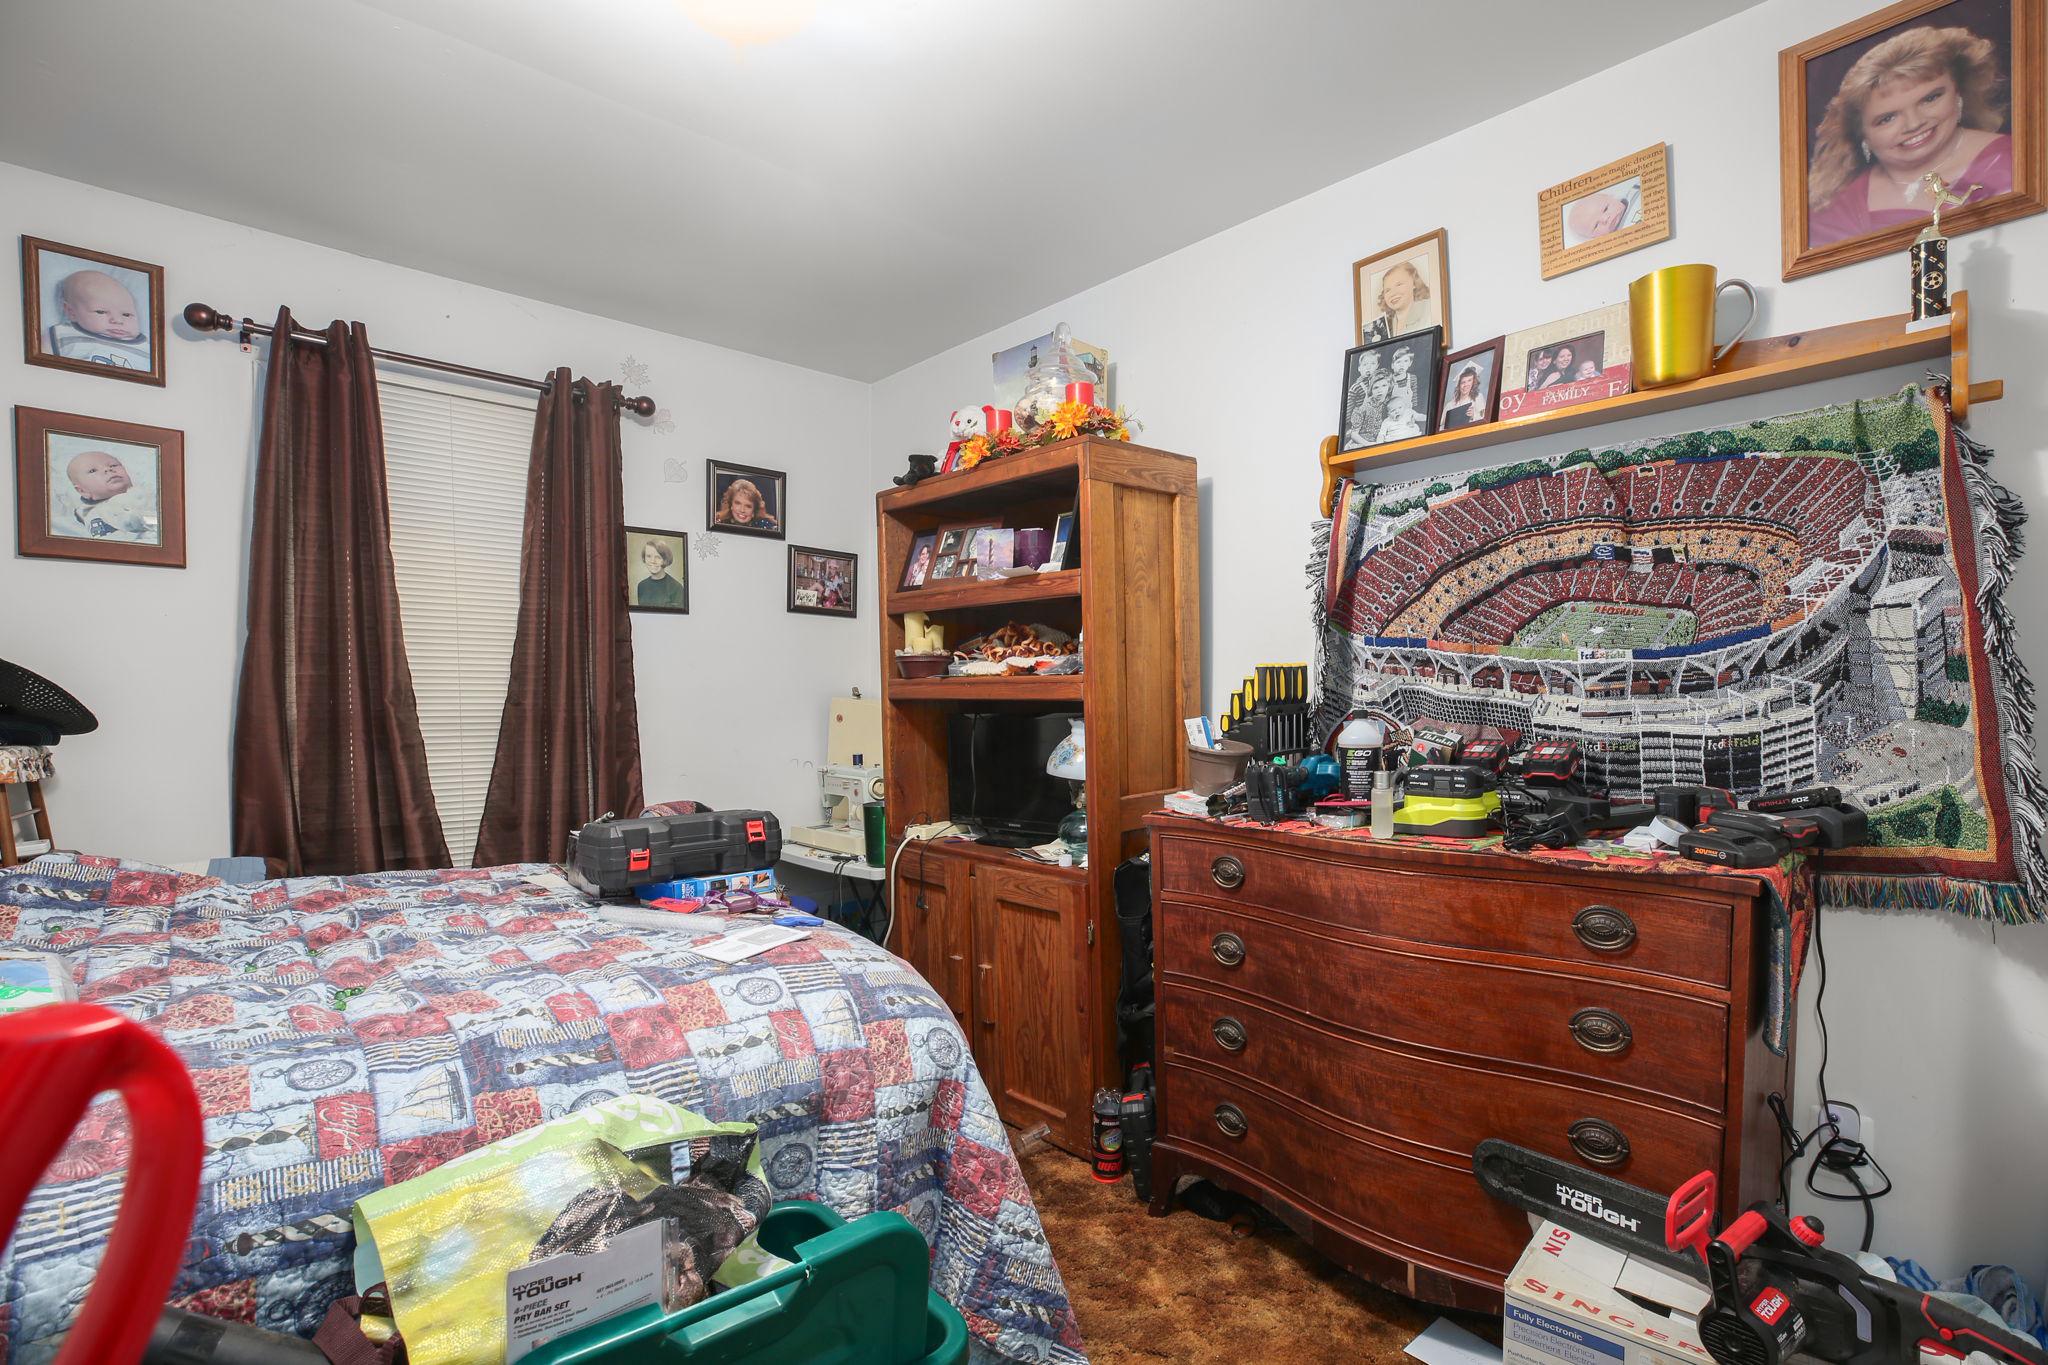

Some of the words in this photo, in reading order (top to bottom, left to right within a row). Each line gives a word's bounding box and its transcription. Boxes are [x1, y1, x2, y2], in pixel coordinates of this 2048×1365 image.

[1540, 176, 1592, 202] Children
[1608, 161, 1631, 175] magic
[1633, 150, 1664, 164] dreams
[1621, 161, 1653, 177] laughter
[1542, 386, 1590, 405] FAMILY
[1346, 749, 1372, 757] EGO
[1791, 796, 1809, 804] 20V
[1556, 1183, 1602, 1206] HYPER
[1556, 1191, 1638, 1232] TOUGH
[512, 1275, 554, 1293] HYPER
[512, 1272, 583, 1301] TOUGH
[513, 1298, 548, 1315] 4-PIECE
[513, 1312, 532, 1324] PRY
[533, 1306, 552, 1318] BAR
[555, 1300, 571, 1312] SET
[1760, 1294, 1785, 1319] TOUGH
[1513, 1309, 1535, 1324] Fully
[1536, 1318, 1583, 1341] Electronic
